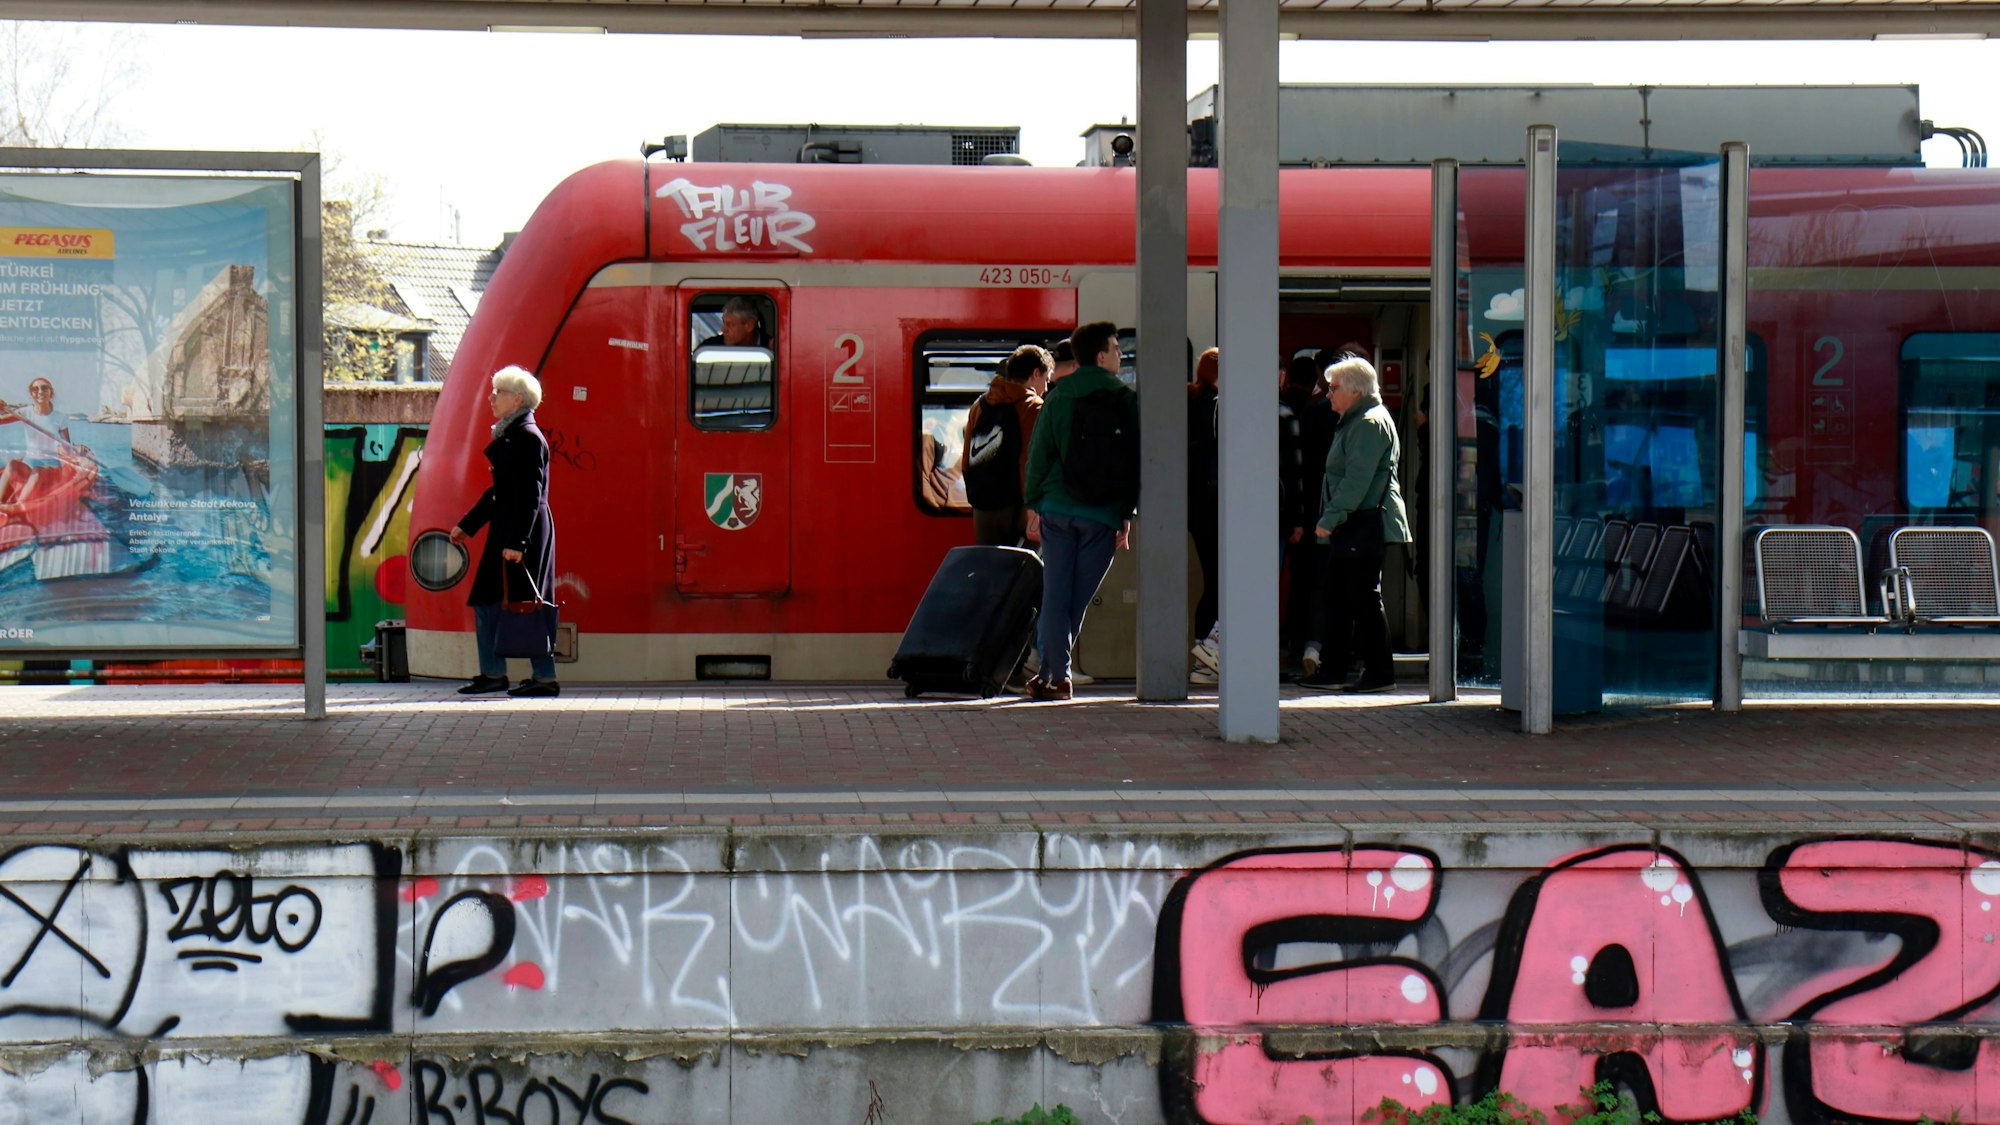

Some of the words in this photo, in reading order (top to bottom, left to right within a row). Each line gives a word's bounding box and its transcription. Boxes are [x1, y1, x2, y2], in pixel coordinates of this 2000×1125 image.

[14, 233, 92, 248] PEGASUS
[979, 268, 1012, 284] 423
[1020, 268, 1072, 285] 050-4
[0, 316, 92, 329] ENTDECKEN
[832, 333, 864, 383] 2
[1812, 335, 1844, 385] 2
[129, 499, 188, 508] Versunkene
[190, 499, 218, 508] Stadt
[219, 499, 256, 508] Kekova
[129, 512, 168, 522] Antalya
